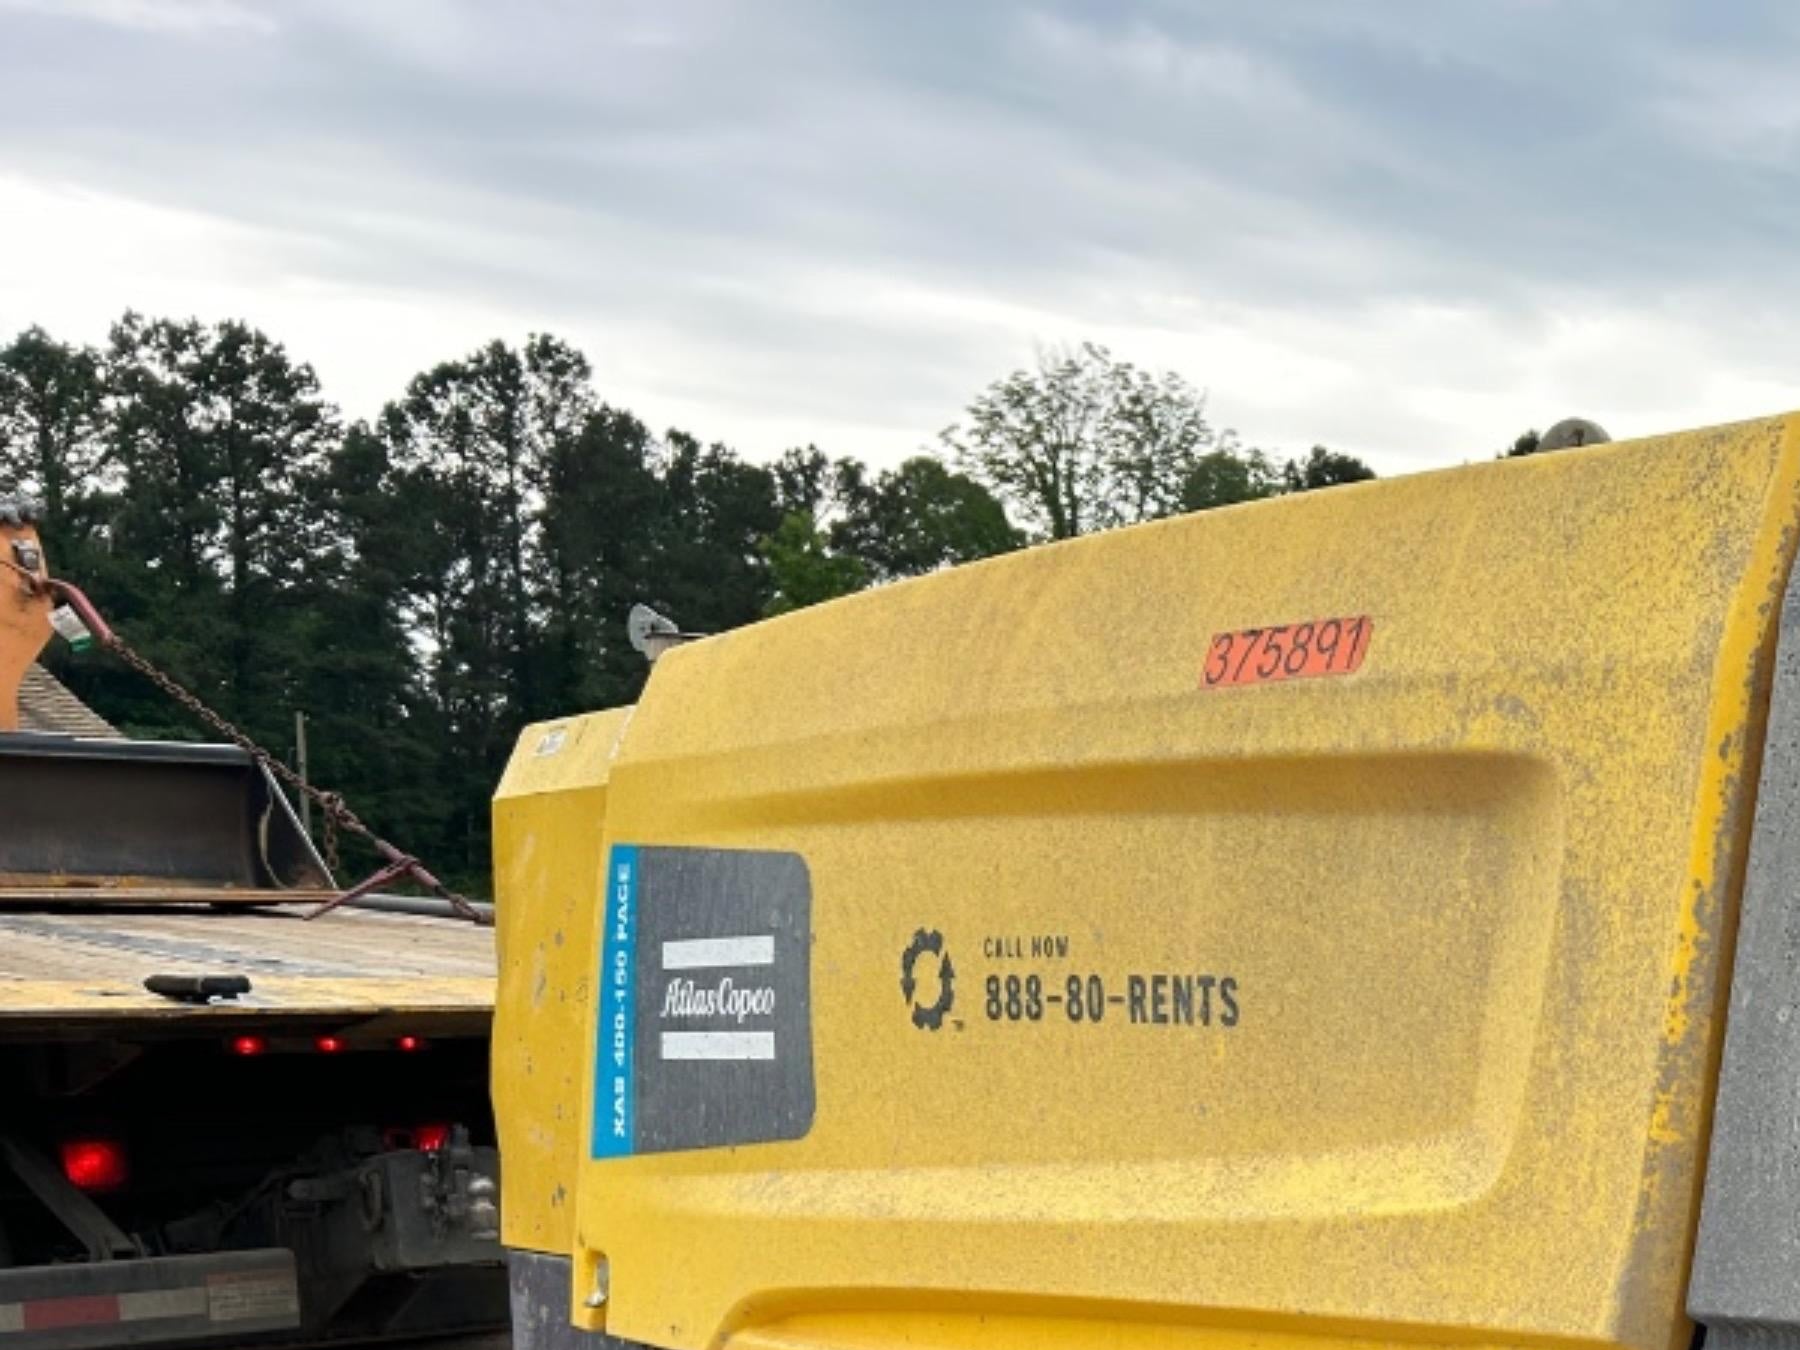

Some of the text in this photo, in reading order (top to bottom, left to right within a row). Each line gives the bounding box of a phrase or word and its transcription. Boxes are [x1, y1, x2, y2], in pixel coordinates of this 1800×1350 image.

[1205, 615, 1366, 684] 375891
[983, 936, 1069, 959] CALL NOW
[985, 973, 1240, 1028] 888-80-RENTS
